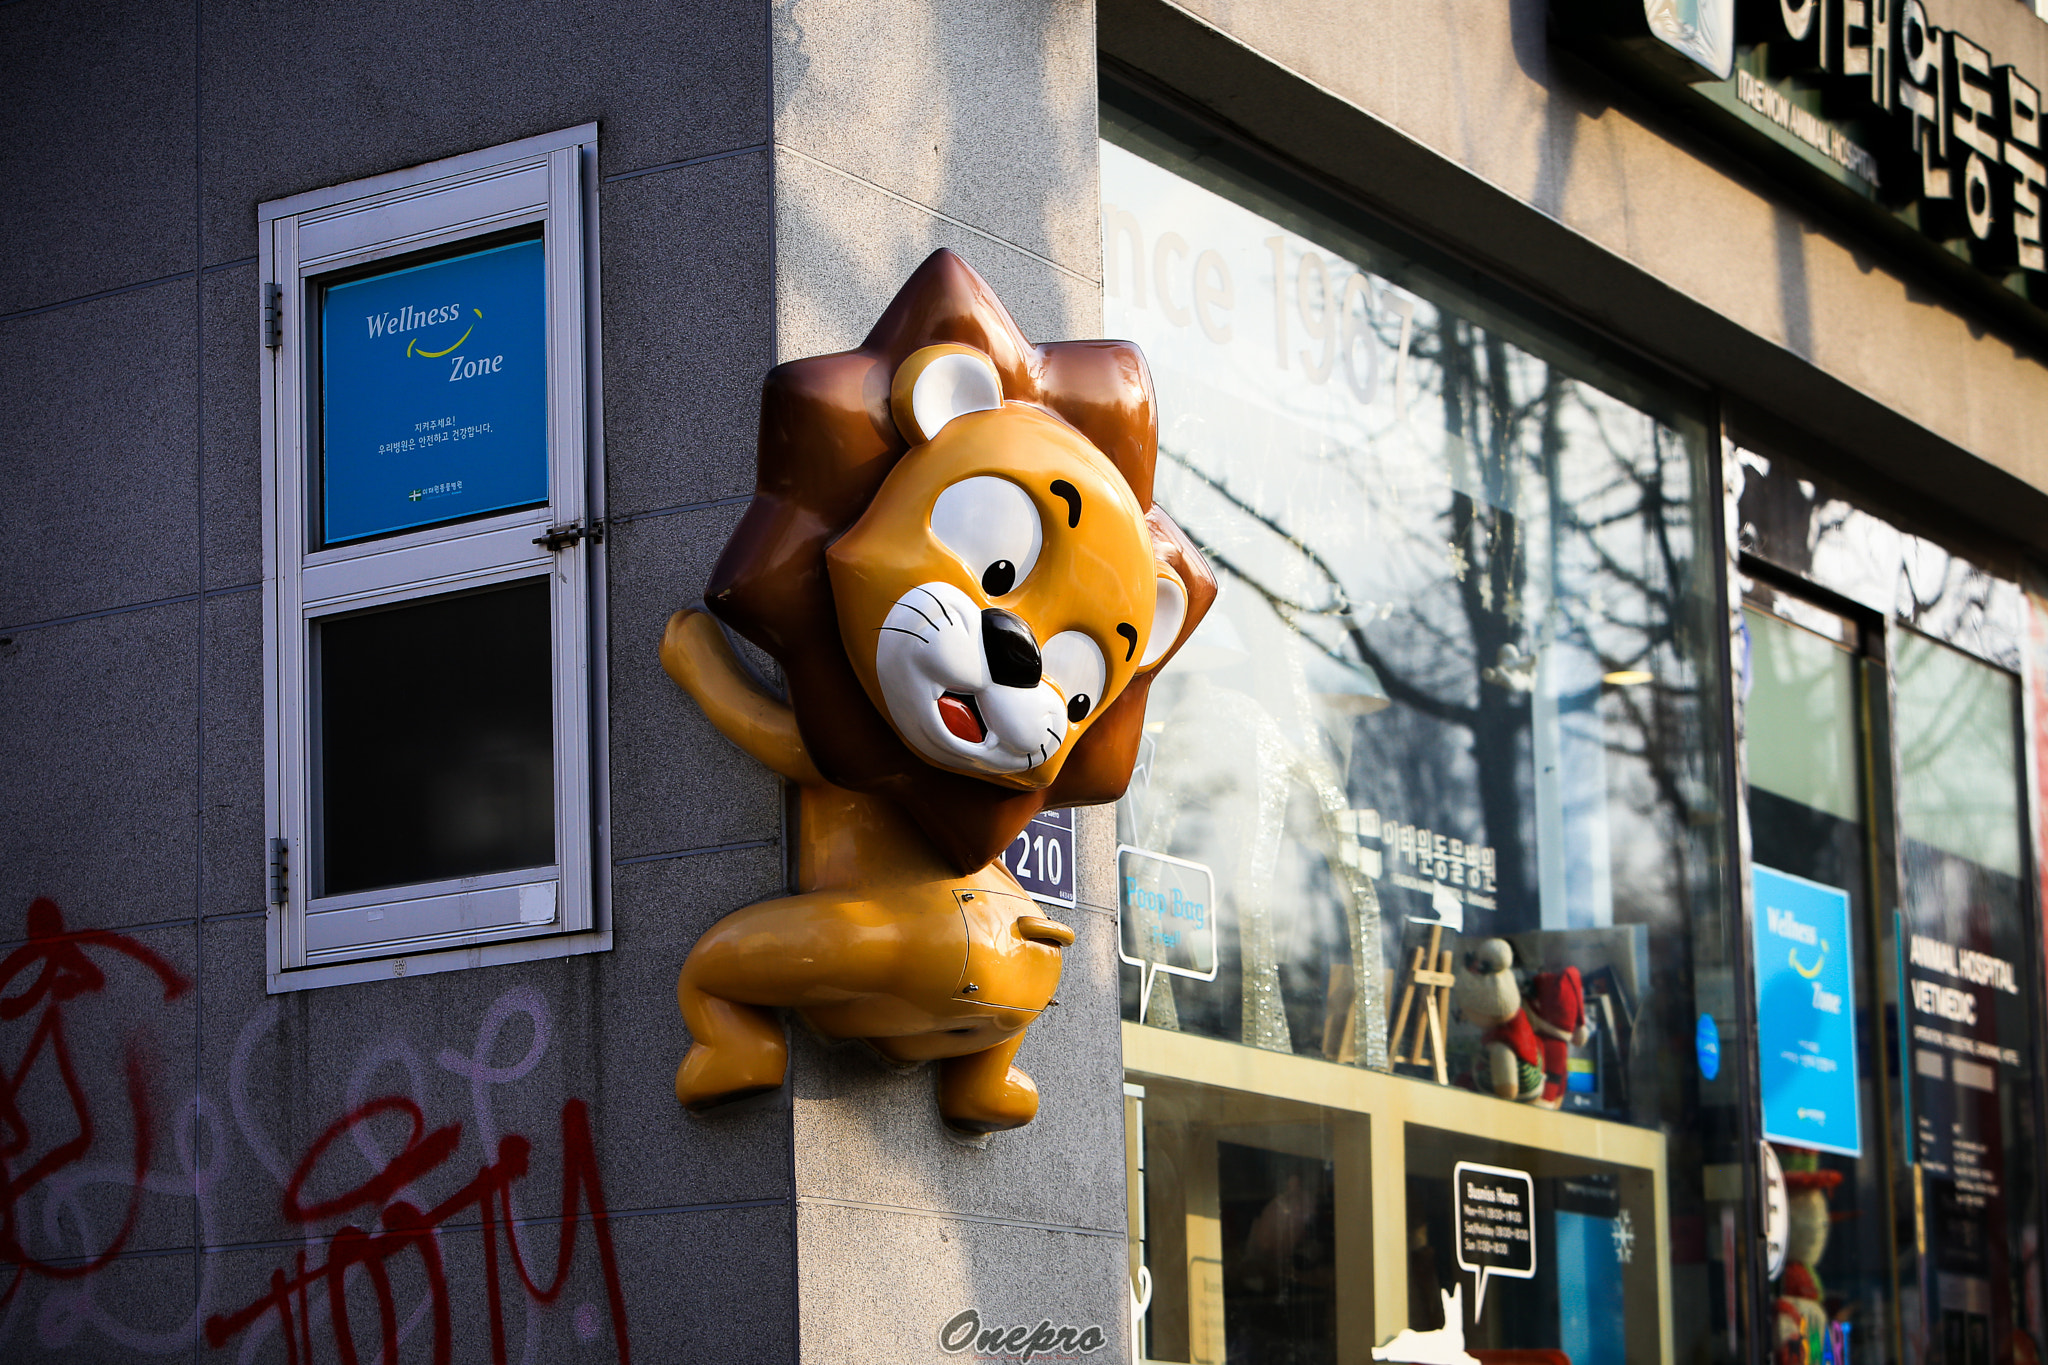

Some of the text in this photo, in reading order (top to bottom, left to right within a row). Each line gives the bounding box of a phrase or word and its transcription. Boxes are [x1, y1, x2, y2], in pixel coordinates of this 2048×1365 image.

[1789, 103, 1830, 157] ANIMAL
[1830, 127, 1881, 189] HOSPITAL
[366, 302, 460, 340] Wellness
[448, 353, 504, 383] Zone
[378, 422, 494, 455] 우리병원은 안전하고 건강합니다.
[414, 415, 456, 433] 지켜주세요!
[1016, 829, 1063, 886] 210
[1382, 819, 1498, 893] 이태원동물병원
[1126, 876, 1205, 930] Poop Bag
[1910, 934, 2019, 996] ANIMAL HOSPITAL
